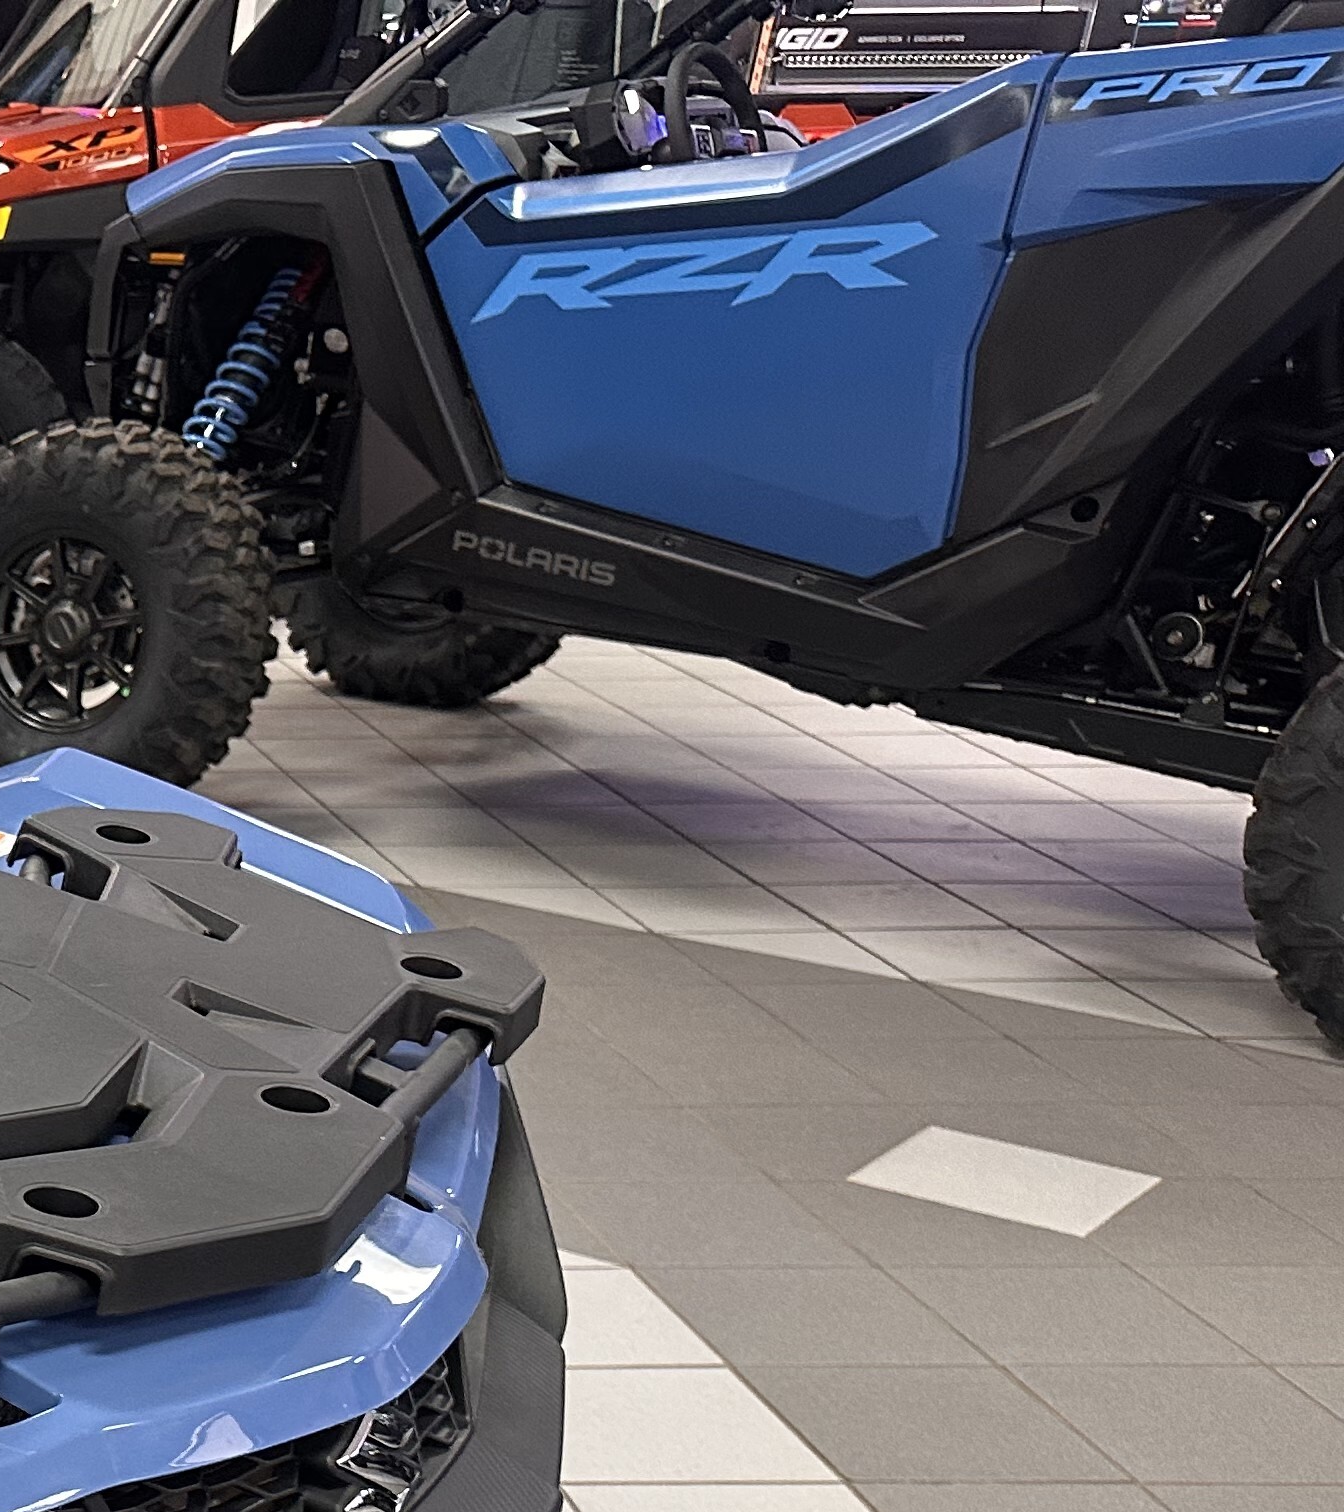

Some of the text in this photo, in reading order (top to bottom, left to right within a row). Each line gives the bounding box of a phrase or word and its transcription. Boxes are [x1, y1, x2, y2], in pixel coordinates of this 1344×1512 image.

[1070, 56, 1333, 112] PRO
[34, 124, 138, 161] XP
[471, 220, 939, 324] RZR
[452, 529, 617, 587] POLARIS
